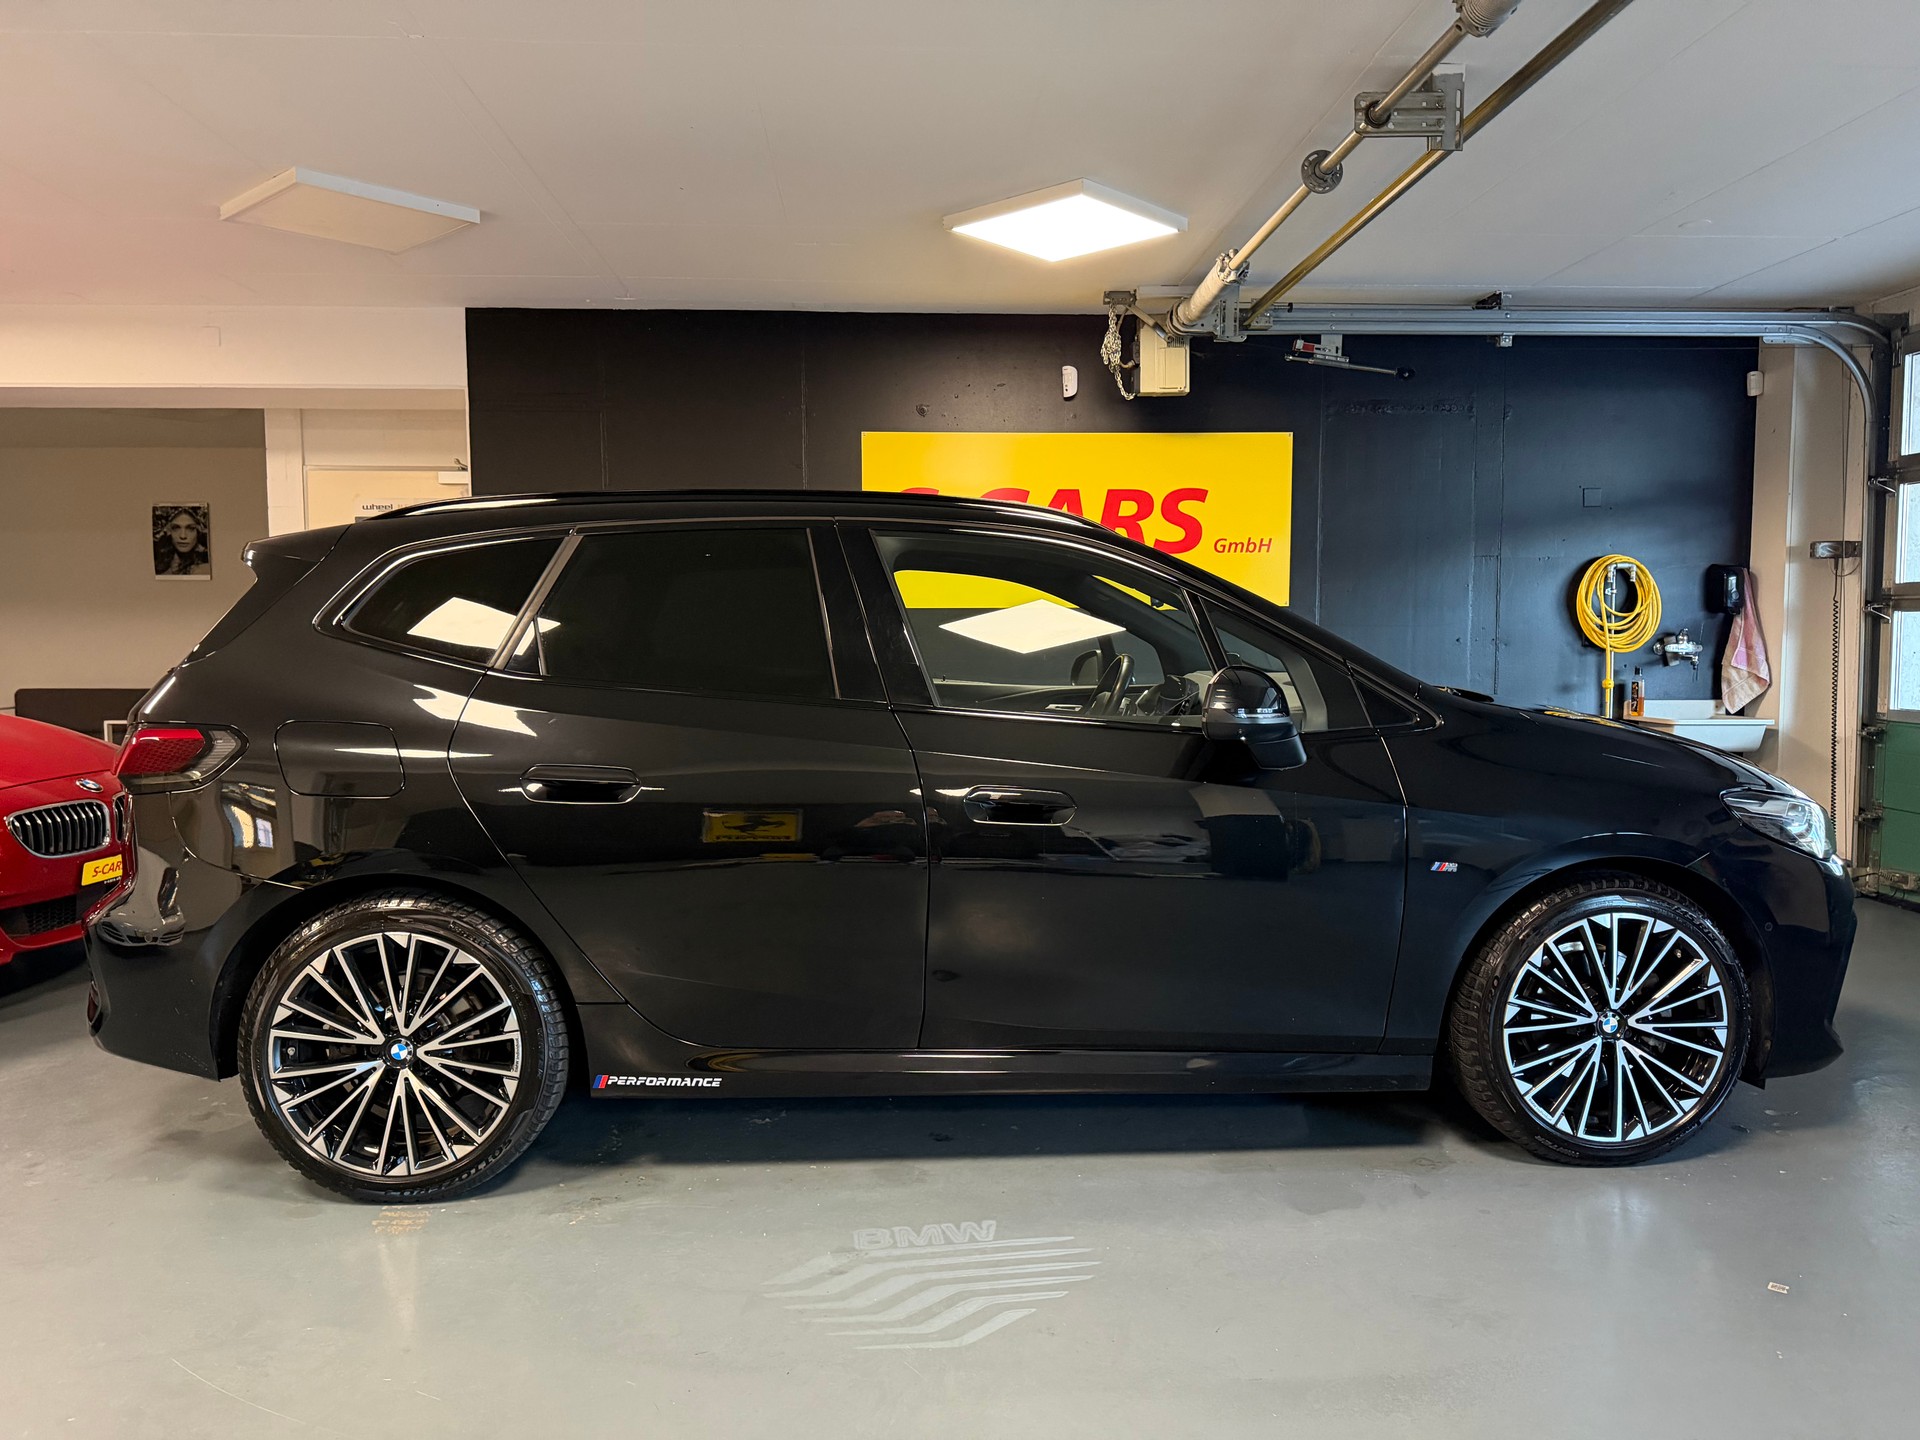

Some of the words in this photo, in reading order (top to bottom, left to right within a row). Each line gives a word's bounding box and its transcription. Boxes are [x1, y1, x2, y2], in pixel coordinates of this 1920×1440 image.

[361, 503, 394, 511] wheel
[1213, 537, 1273, 554] GmbH
[92, 861, 123, 878] S-CAR
[607, 1075, 723, 1088] PERFORMANCE
[853, 1219, 998, 1251] BMW
